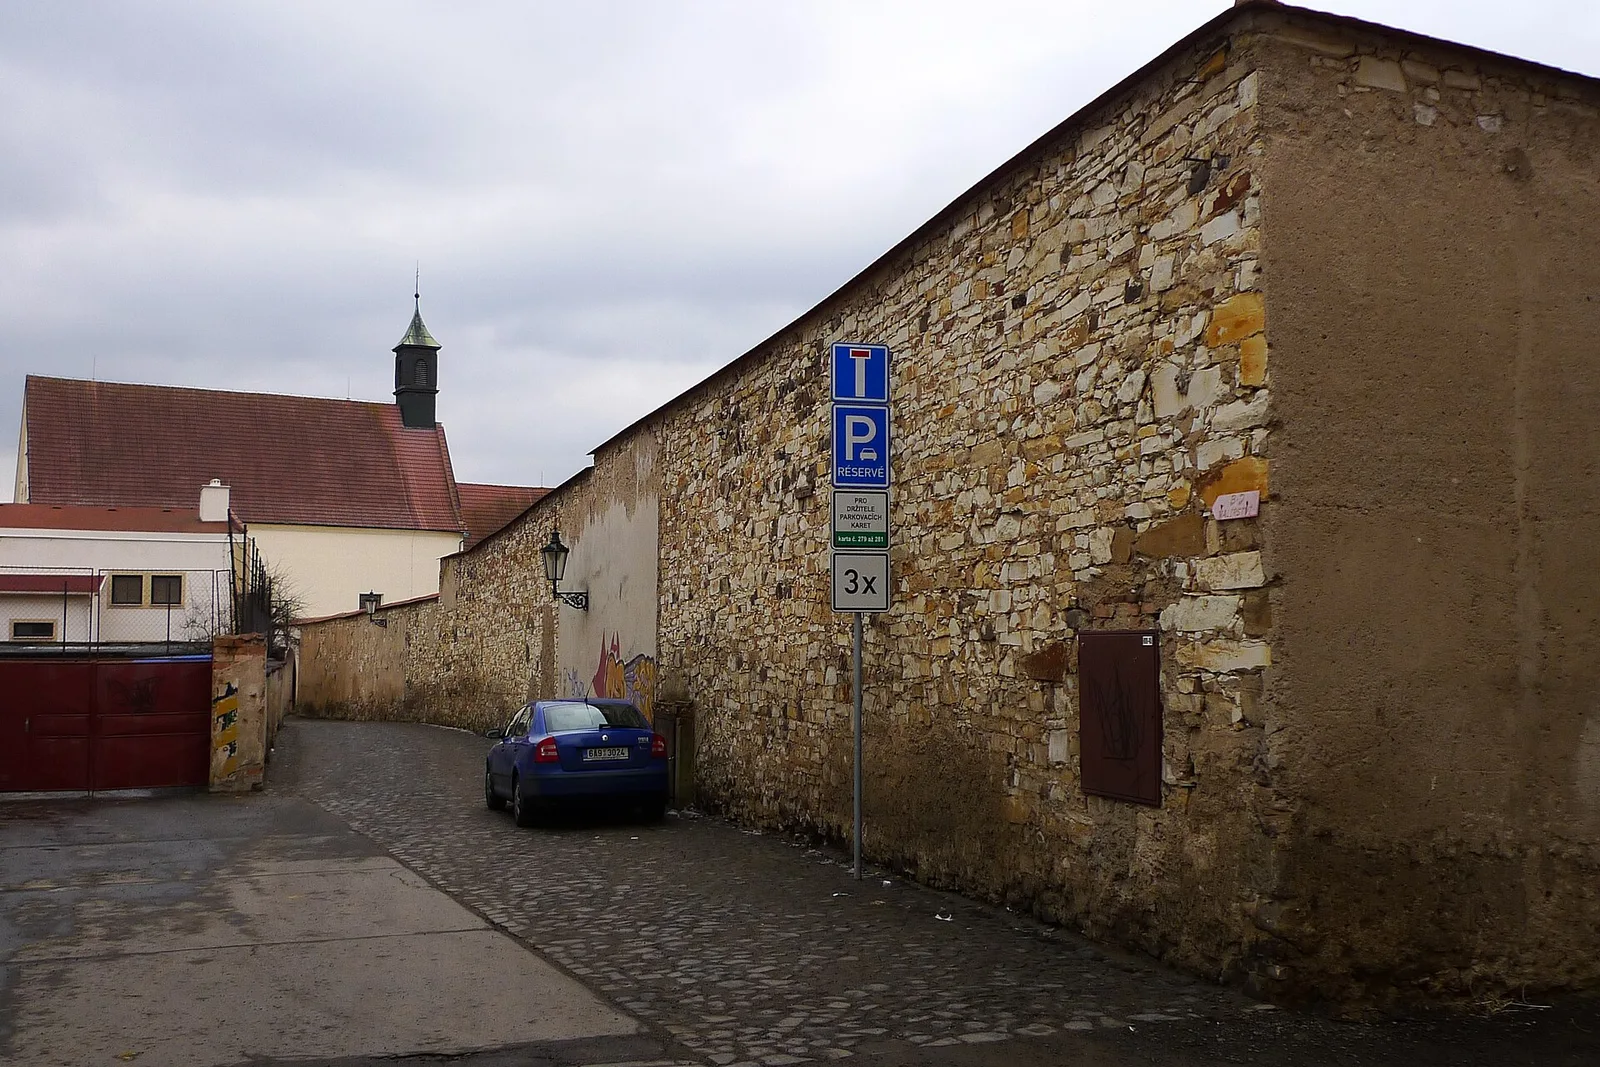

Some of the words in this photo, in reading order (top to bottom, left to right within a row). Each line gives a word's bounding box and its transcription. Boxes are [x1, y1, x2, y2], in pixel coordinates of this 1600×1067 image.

[845, 415, 877, 461] P
[838, 465, 885, 478] RÉSERVÉ
[839, 513, 883, 521] PARKOVACÍCH
[844, 568, 878, 595] 3x
